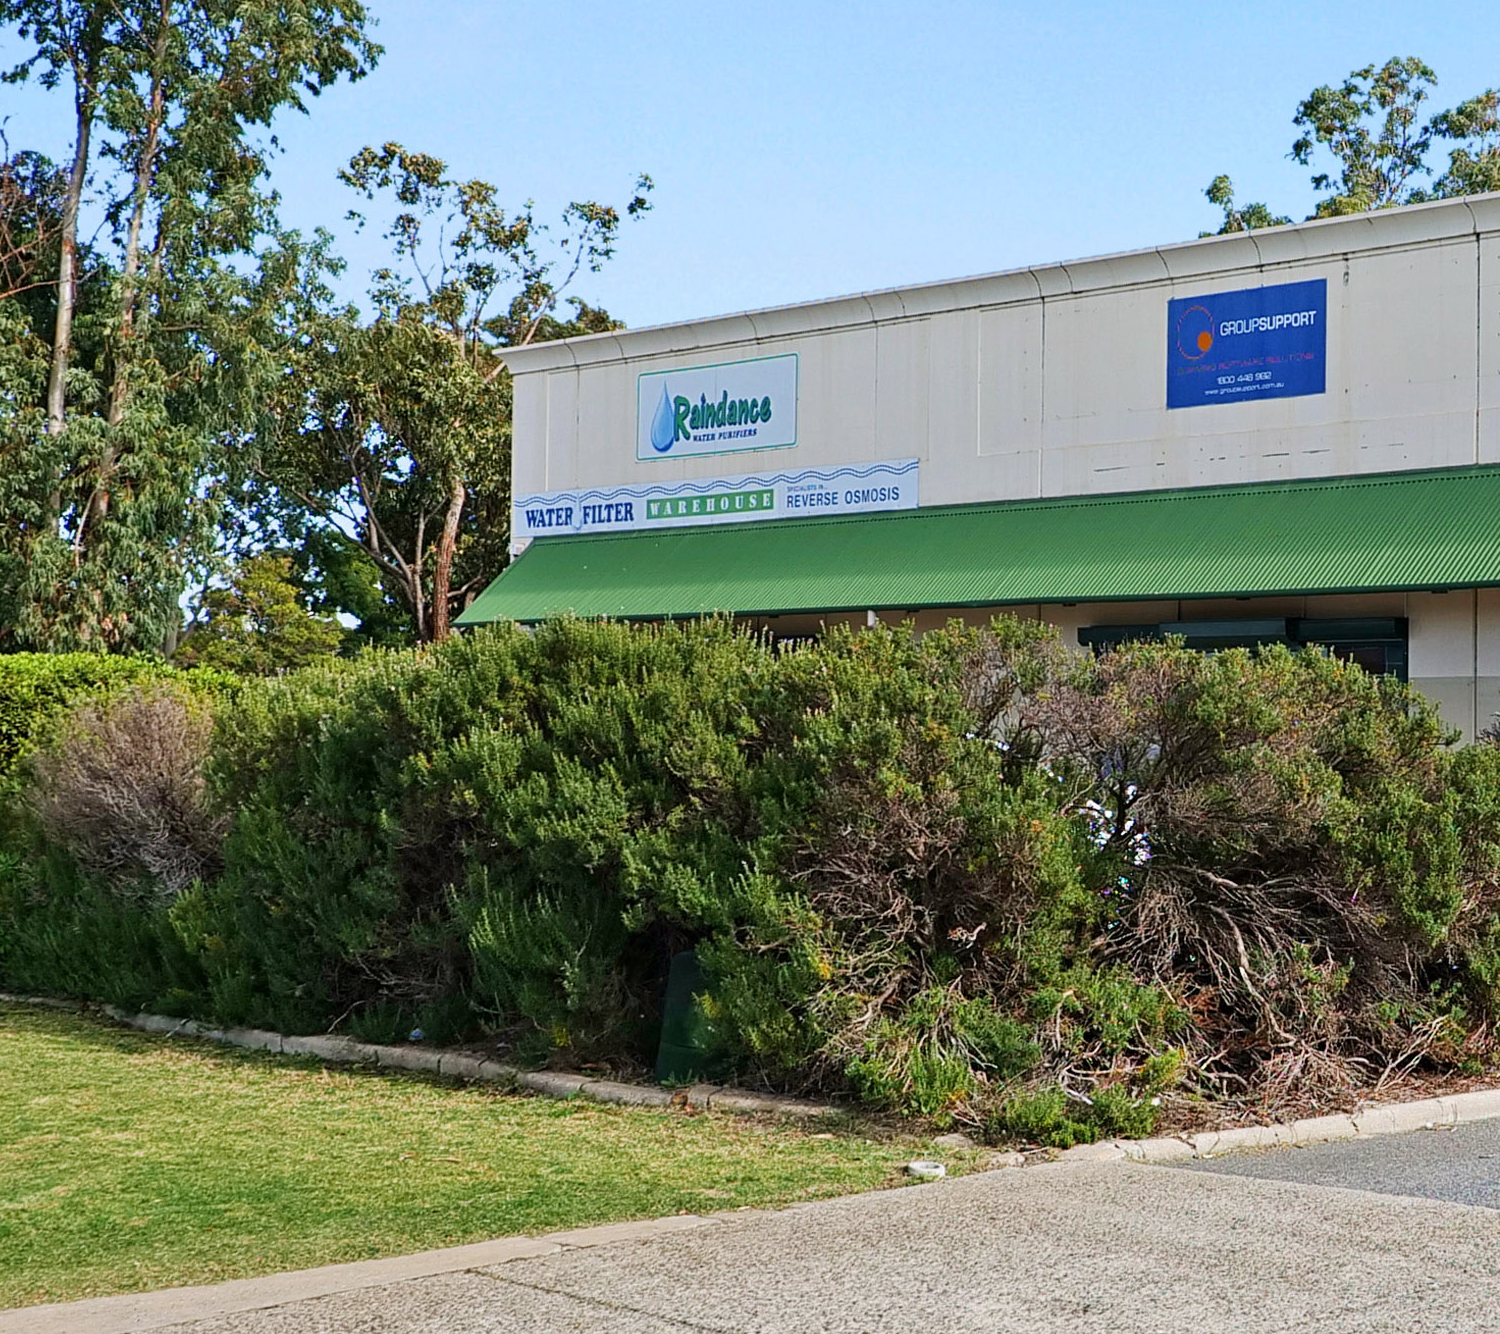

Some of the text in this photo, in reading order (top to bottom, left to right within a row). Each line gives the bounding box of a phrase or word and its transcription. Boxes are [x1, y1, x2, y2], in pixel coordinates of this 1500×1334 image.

[1219, 310, 1317, 337] GROUPSUPPORT
[673, 389, 772, 442] Raindance
[692, 428, 758, 442] WATER PURIFIERS
[525, 493, 771, 528] WATER FILTER WAREHOUSE
[786, 486, 900, 508] REVERSE OSMOSIS
